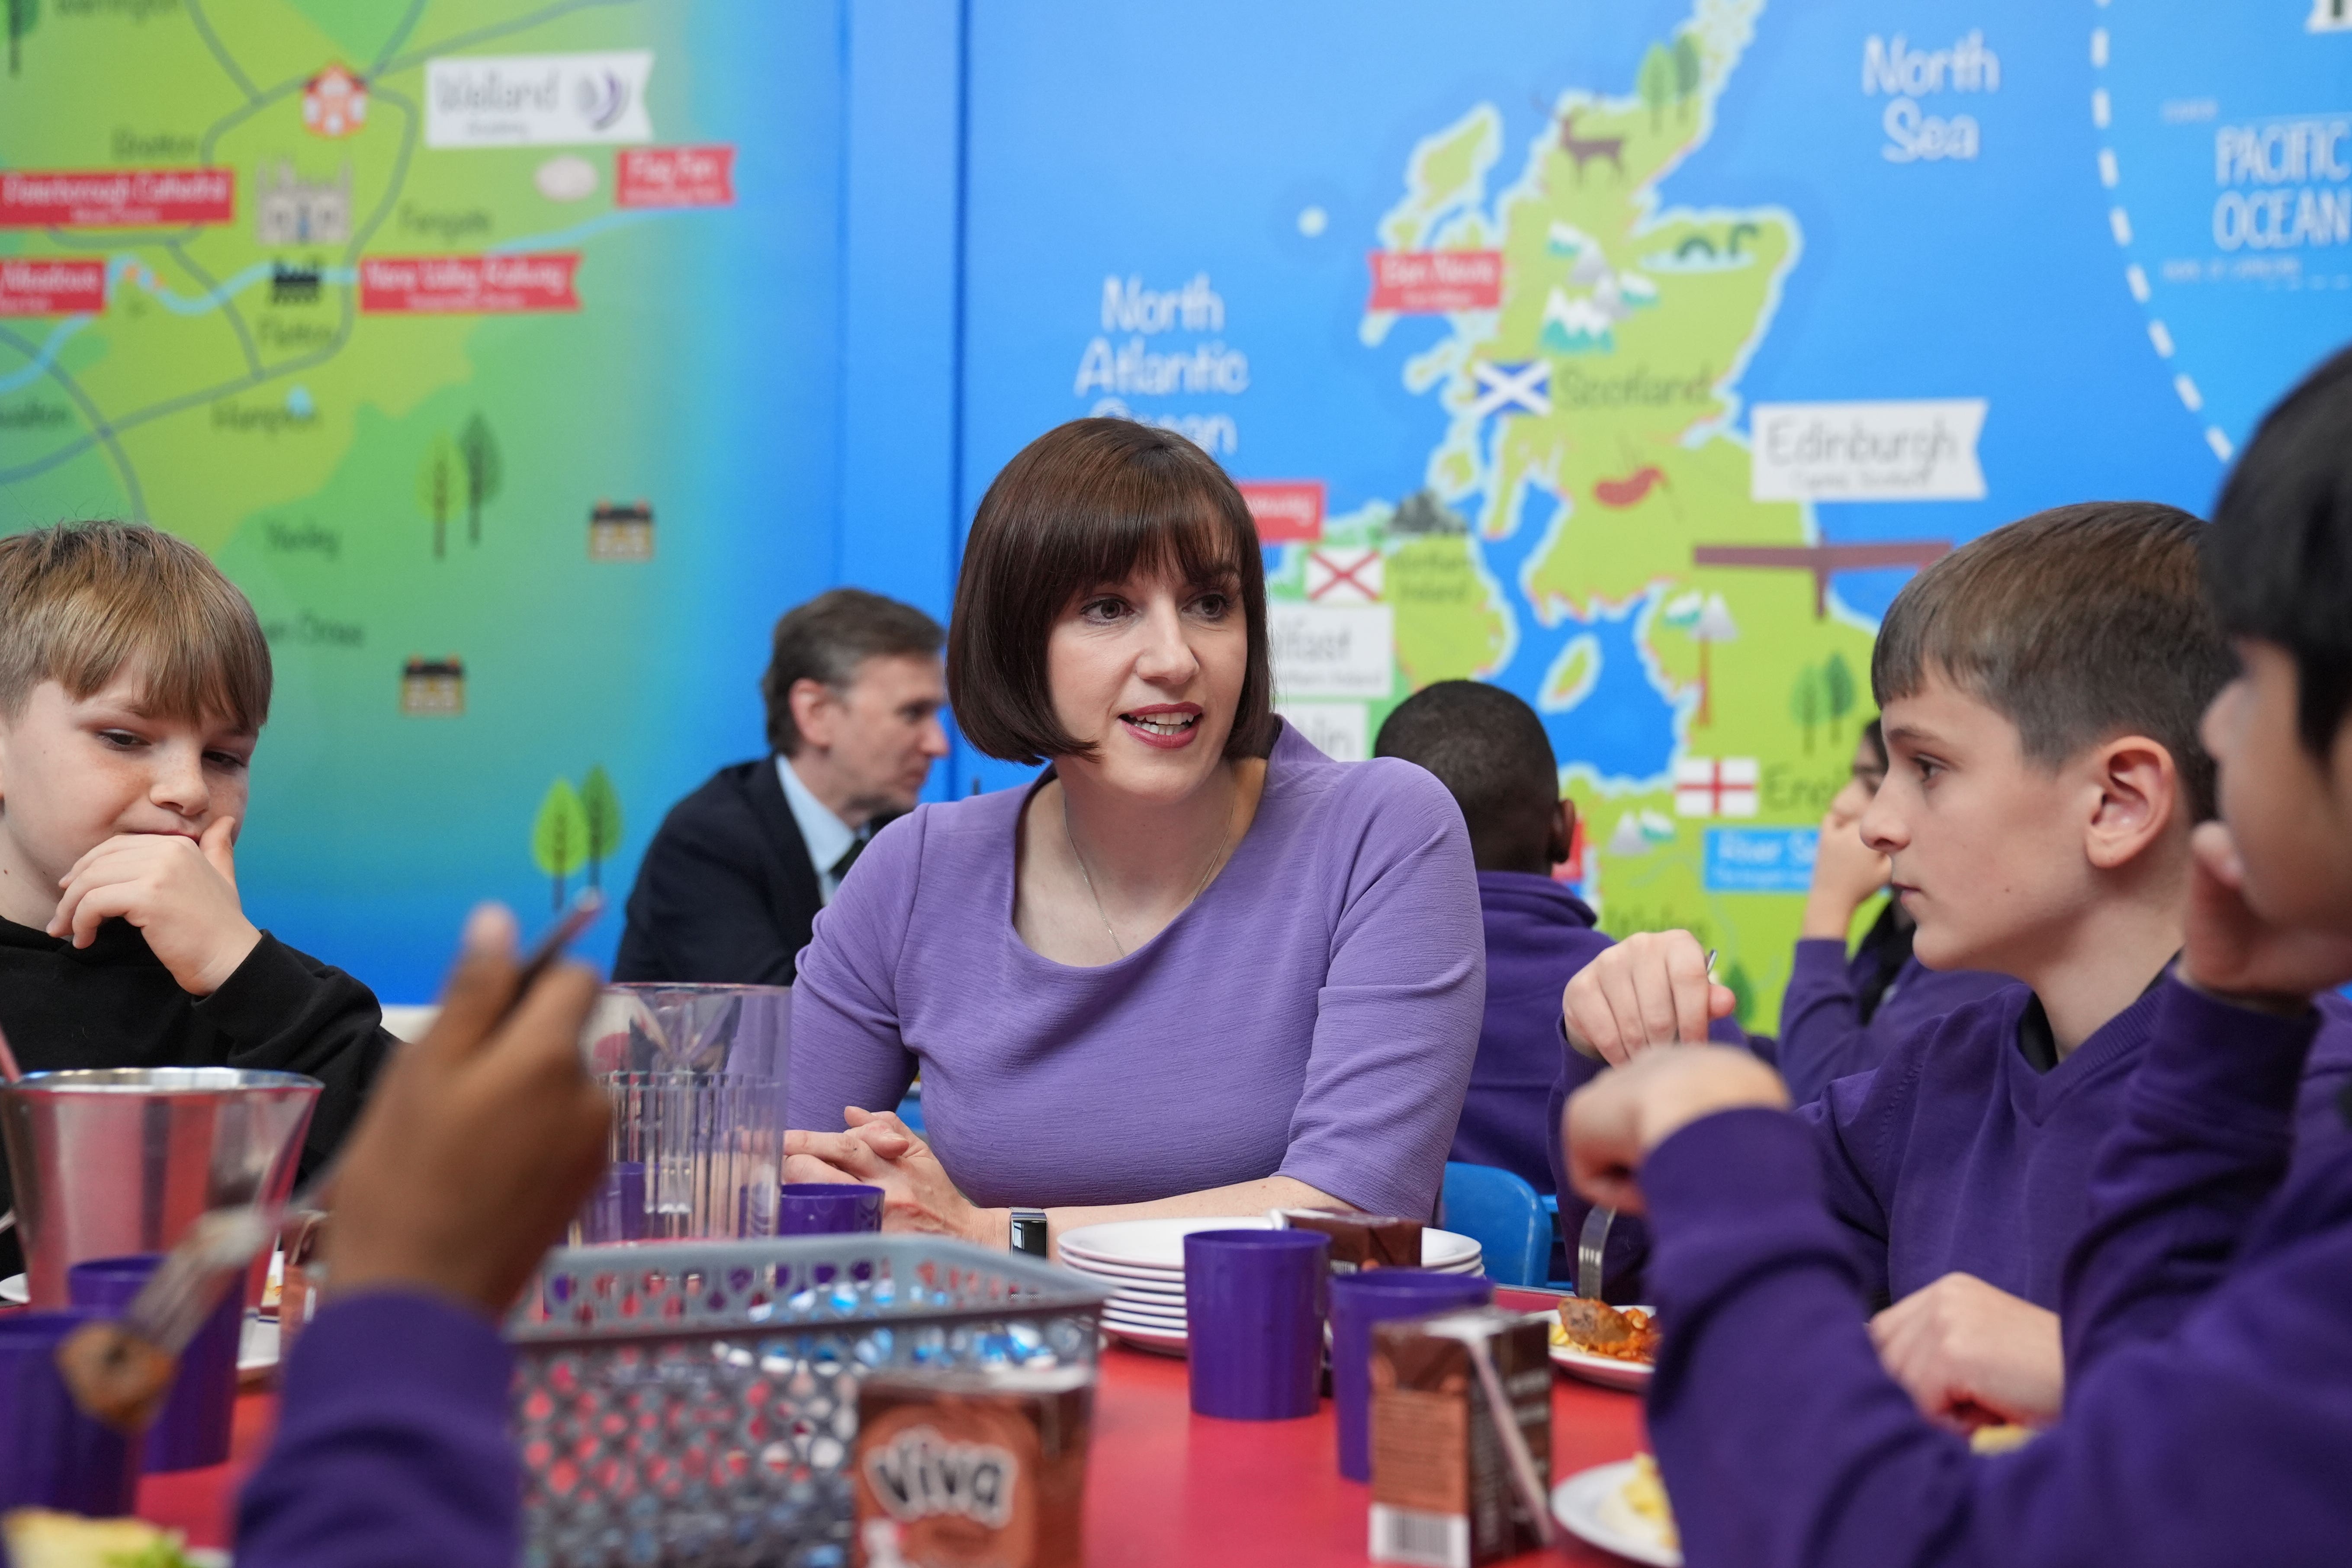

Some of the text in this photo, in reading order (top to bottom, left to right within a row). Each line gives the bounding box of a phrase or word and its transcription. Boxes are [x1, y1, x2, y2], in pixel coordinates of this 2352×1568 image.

[1863, 29, 2001, 96] North
[1882, 96, 1980, 163] Sea
[2214, 122, 2351, 186] PACIFIC
[2213, 188, 2352, 251] OCEAN
[1101, 273, 1225, 334] North
[1073, 336, 1250, 397] Atlantic
[1766, 414, 1957, 477] Edinburgh
